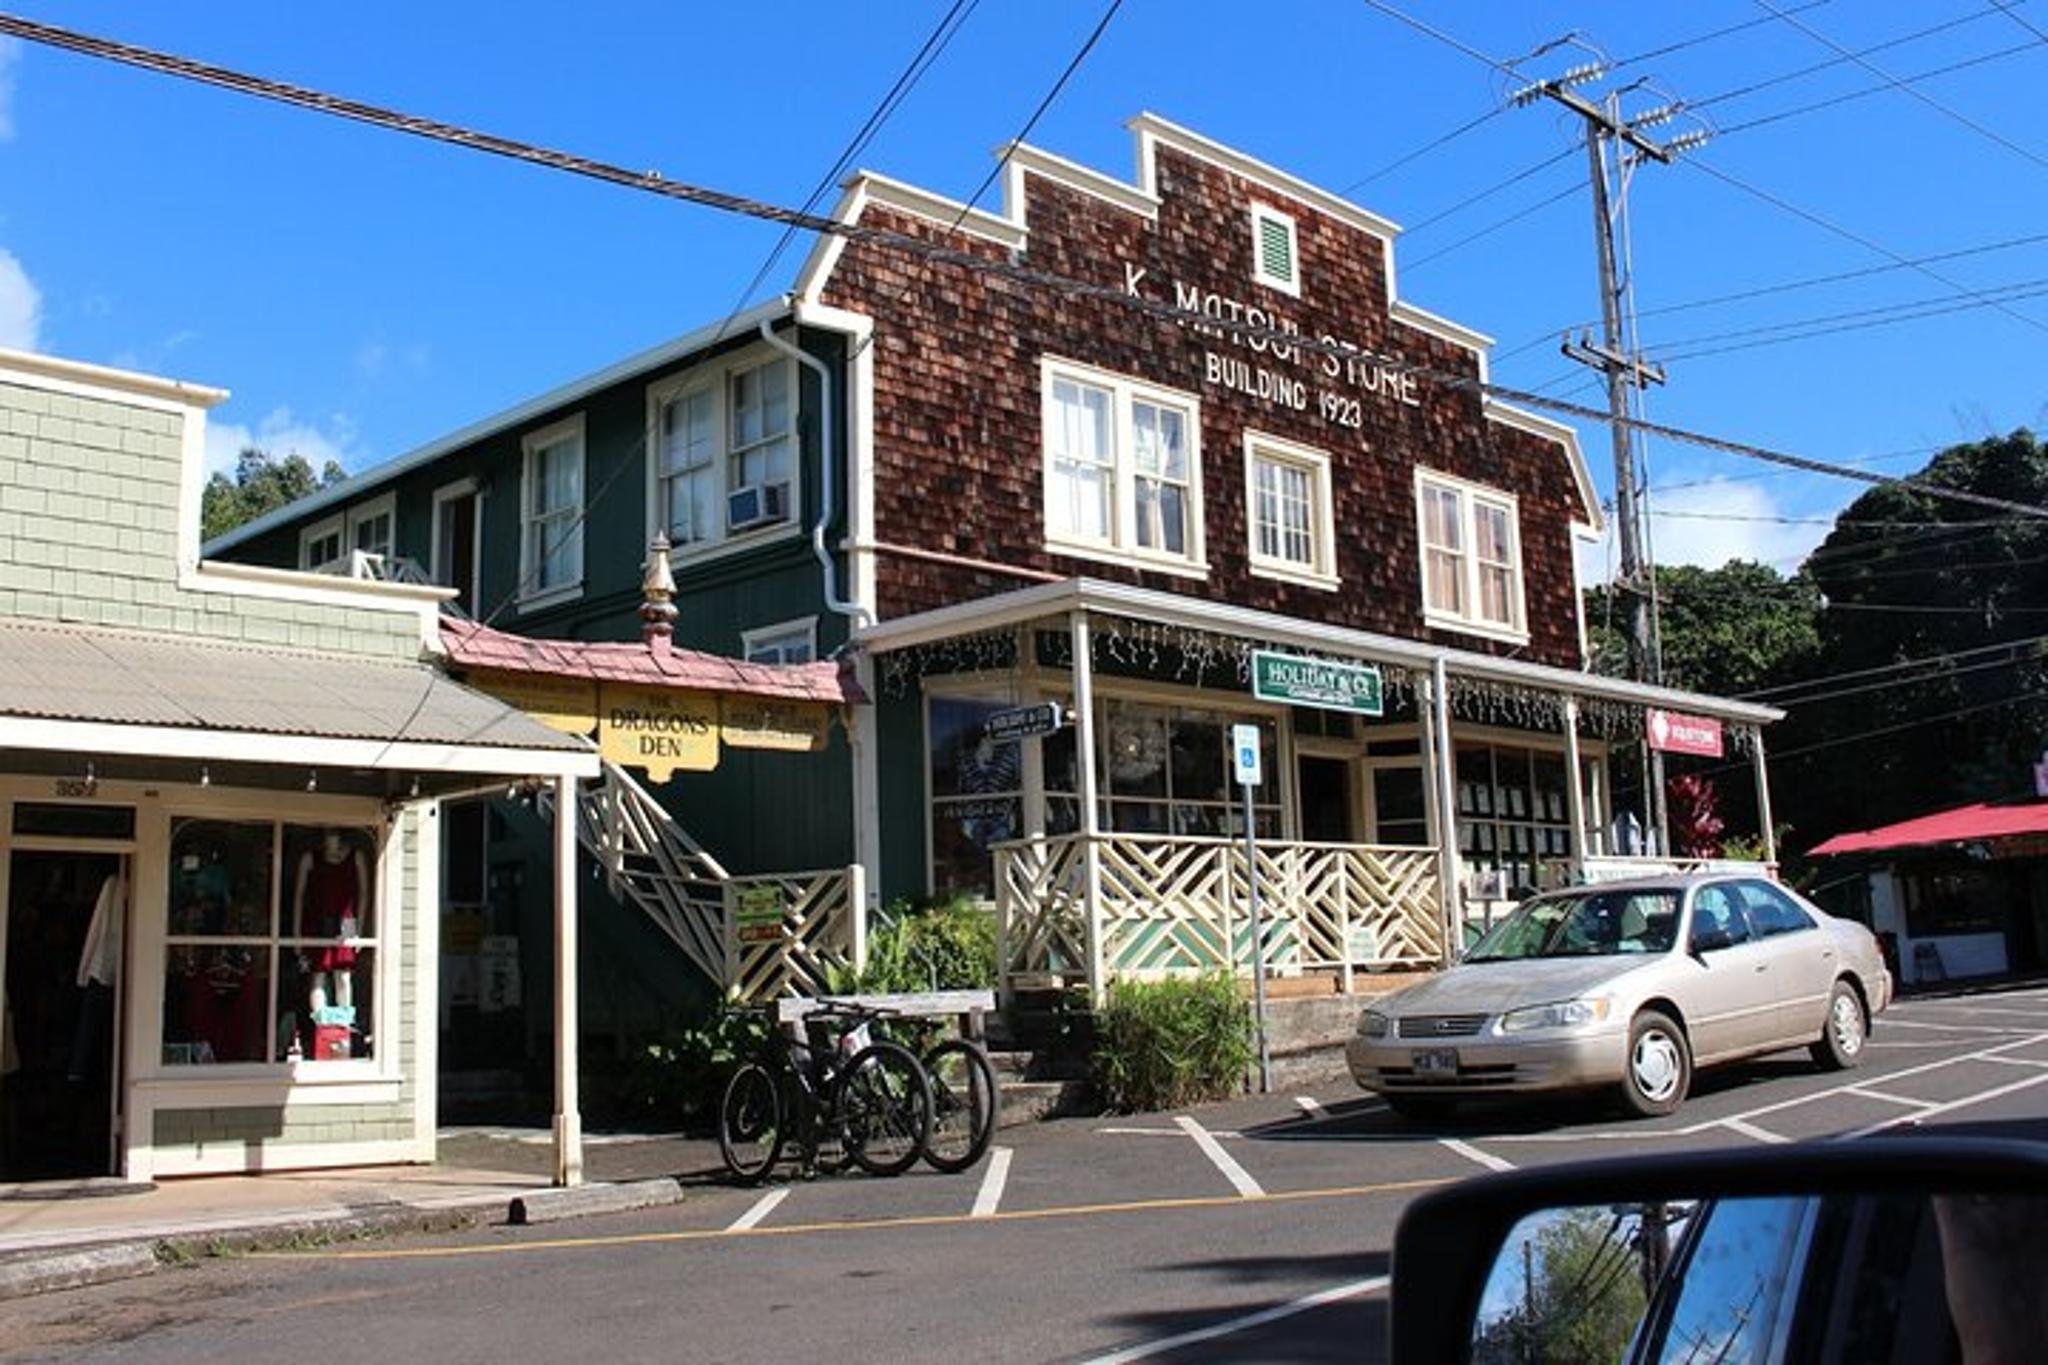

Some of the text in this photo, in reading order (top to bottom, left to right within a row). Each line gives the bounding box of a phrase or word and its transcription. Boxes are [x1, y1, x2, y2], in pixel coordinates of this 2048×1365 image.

[1205, 351, 1363, 429] BUILDING 1923
[1322, 334, 1420, 408] STORE
[610, 708, 710, 736] DRAGONS
[639, 736, 682, 758] DEN
